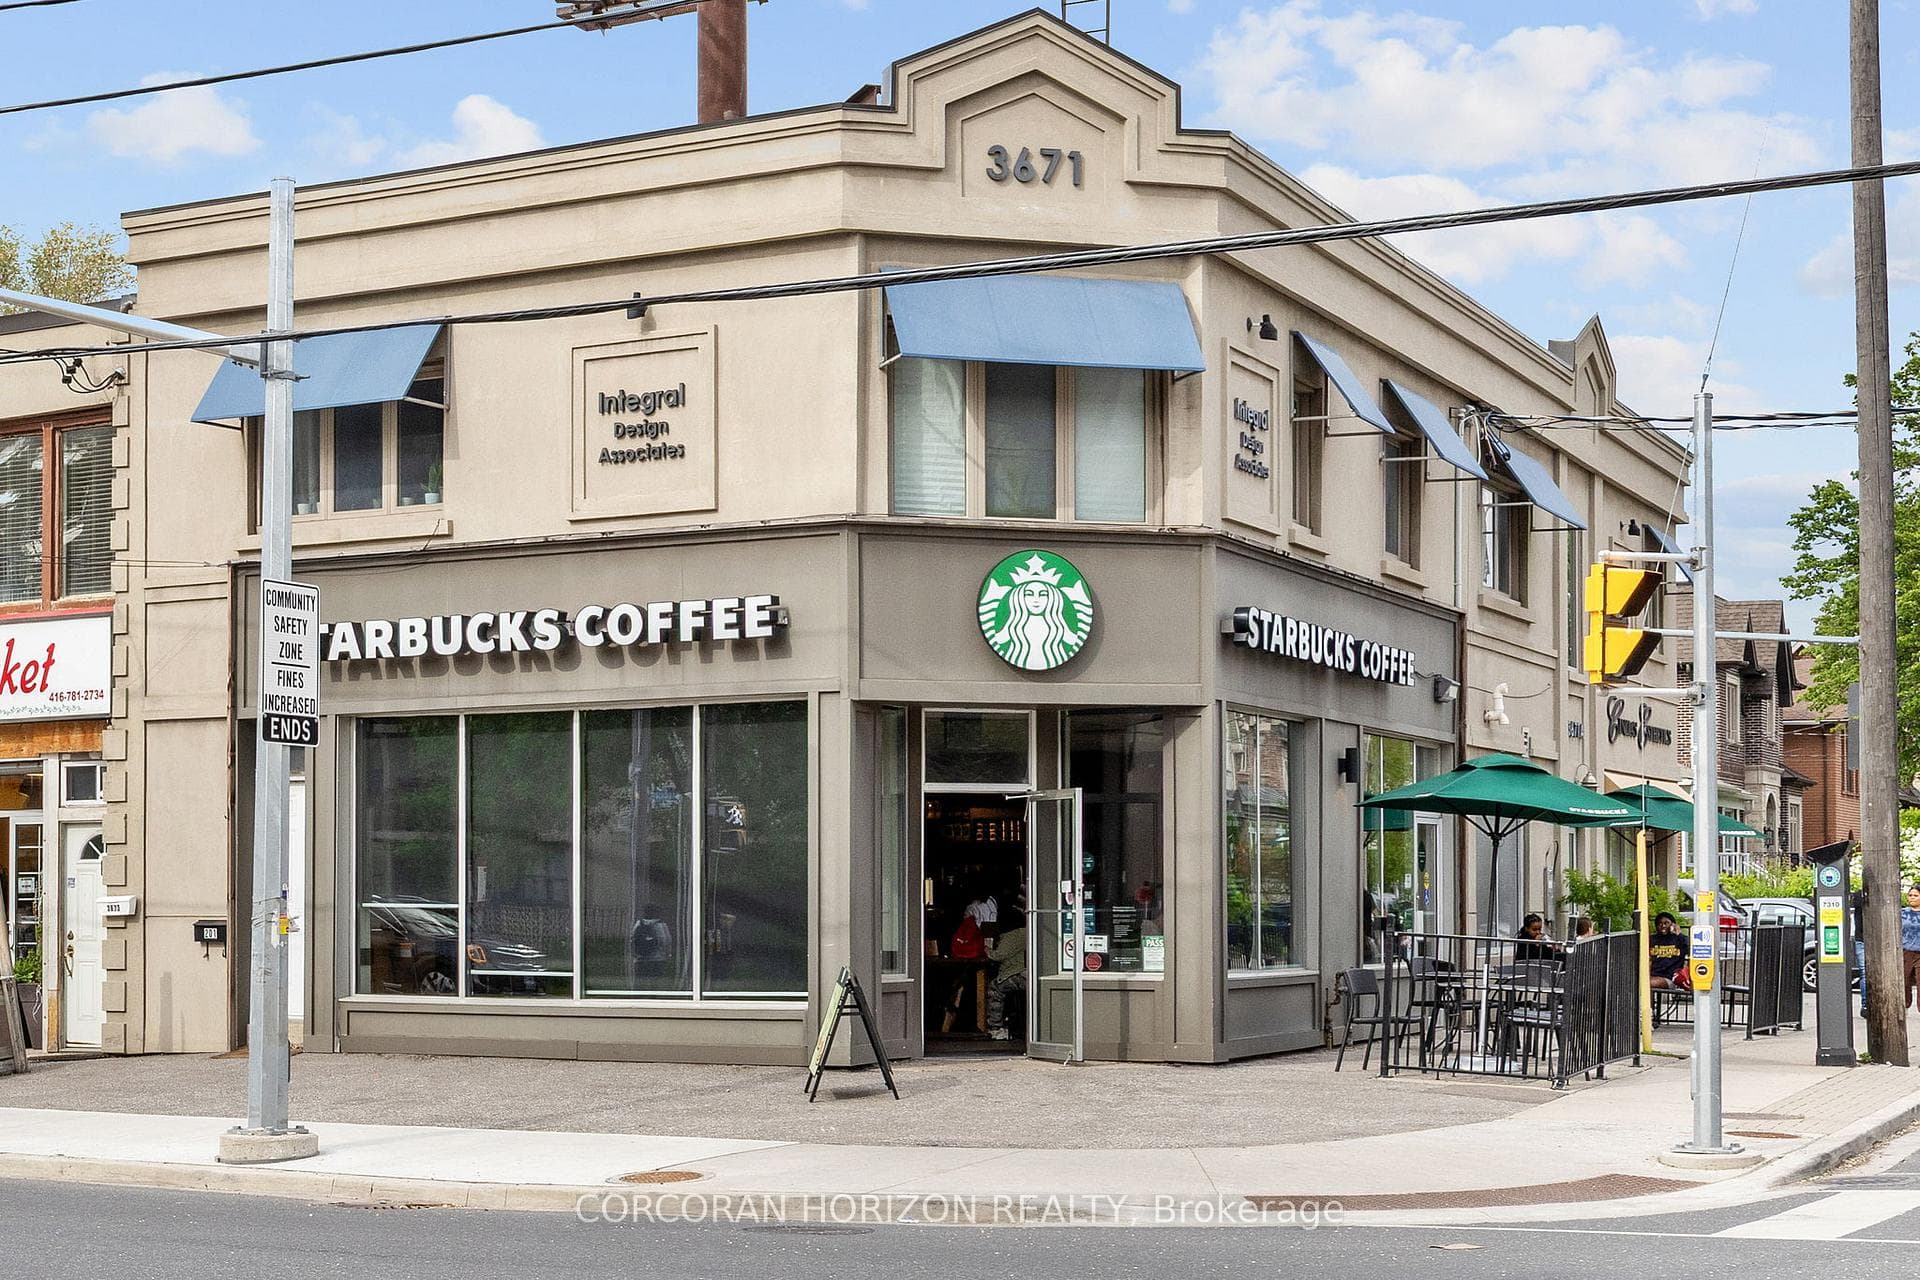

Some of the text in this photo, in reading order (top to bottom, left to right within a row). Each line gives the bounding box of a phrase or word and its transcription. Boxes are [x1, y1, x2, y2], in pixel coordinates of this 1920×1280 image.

[985, 144, 1082, 187] 3671
[598, 382, 686, 415] Integral
[613, 419, 670, 439] Design
[598, 442, 686, 465] Associates
[266, 588, 316, 613] COMMUNITY
[274, 615, 308, 636] SAFETY
[574, 594, 775, 648] COFFEE
[279, 641, 303, 661] ZONE
[1247, 606, 1416, 687] STARBUCKS COFFEE
[277, 669, 304, 689] FINES
[49, 689, 104, 702] 416-781-2734
[265, 693, 316, 715] INCREASED
[270, 717, 312, 742] ENDS
[204, 928, 217, 939] 201
[1146, 939, 1164, 948] PASS
